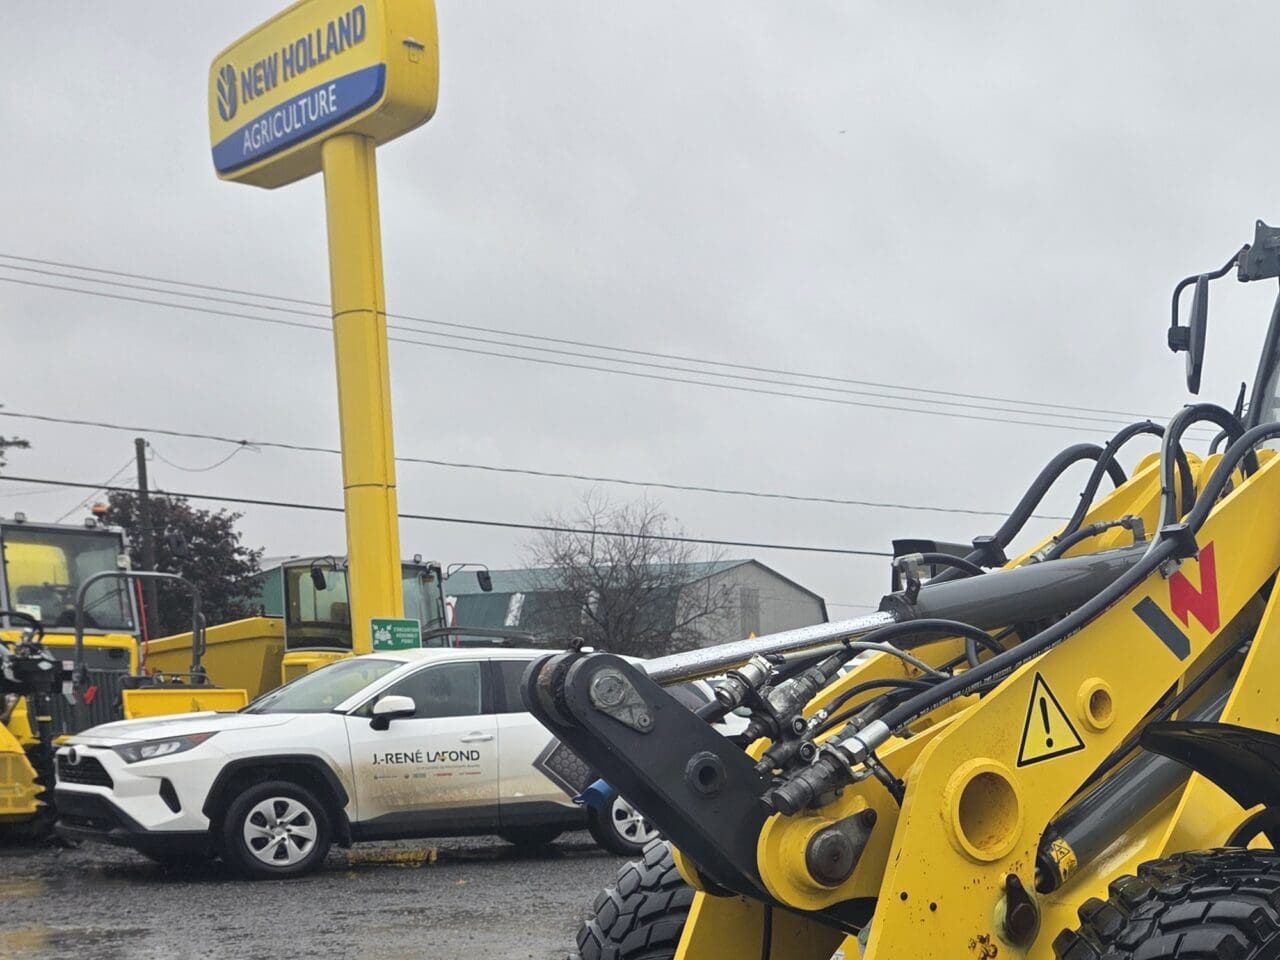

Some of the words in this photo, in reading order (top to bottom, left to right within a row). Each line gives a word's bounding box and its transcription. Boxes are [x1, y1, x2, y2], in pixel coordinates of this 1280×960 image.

[240, 52, 278, 104] NEW
[282, 4, 366, 83] HOLLAND
[243, 84, 338, 155] AGRICULTURE
[372, 750, 424, 765] J.-RENÉ
[426, 750, 481, 763] LAFOND
